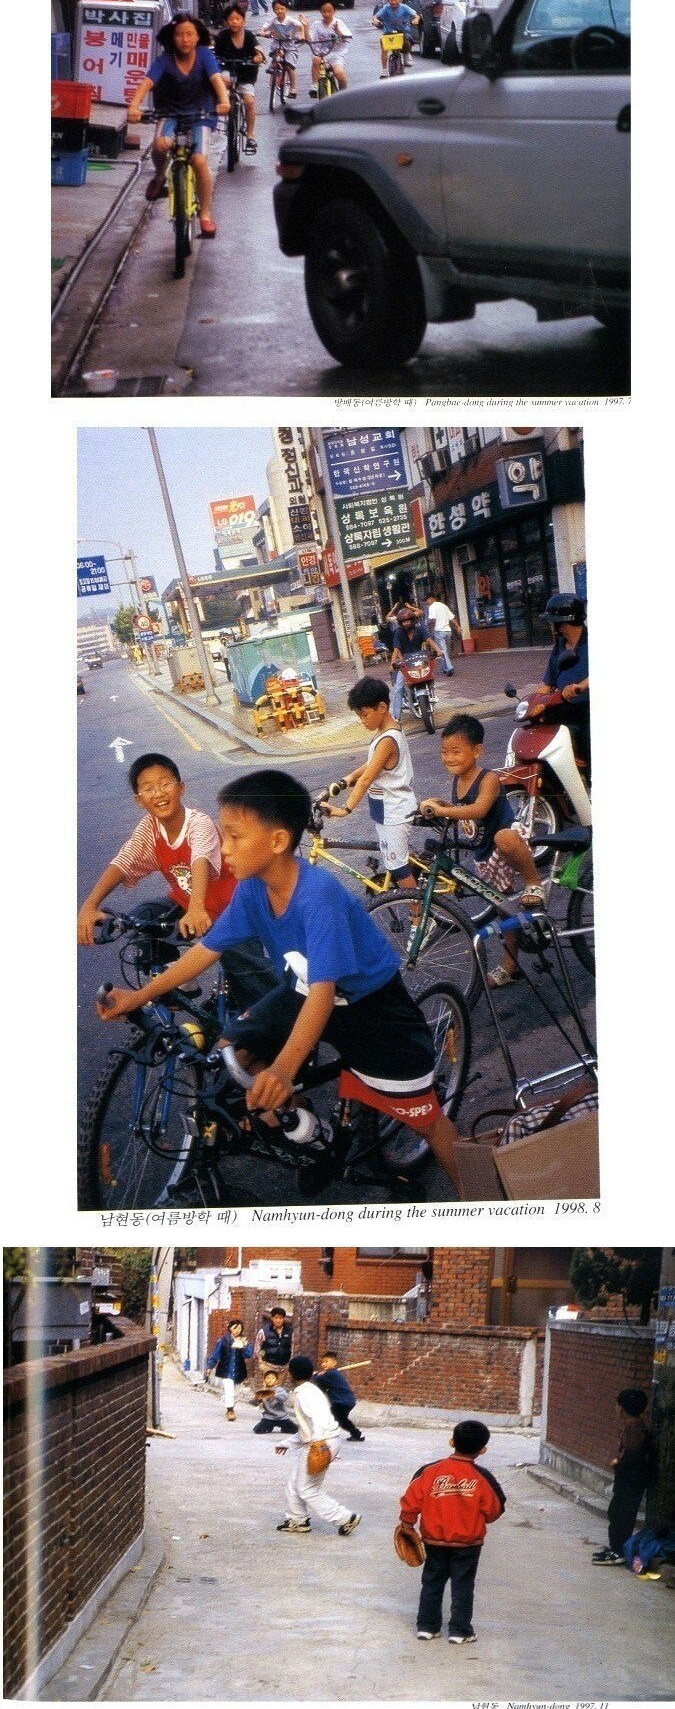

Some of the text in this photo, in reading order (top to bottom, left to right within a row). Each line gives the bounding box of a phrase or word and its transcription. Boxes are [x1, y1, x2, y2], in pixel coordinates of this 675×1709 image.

[84, 10, 152, 25] 박사집
[109, 32, 124, 68] 메기
[127, 33, 150, 49] 민물
[346, 429, 396, 447] 남성교회
[333, 457, 400, 478] 한국신학연구원
[507, 456, 544, 501] 약
[340, 502, 408, 525] 상록보육원
[344, 522, 411, 544] 상록자립 생활관
[300, 554, 316, 567] 안경
